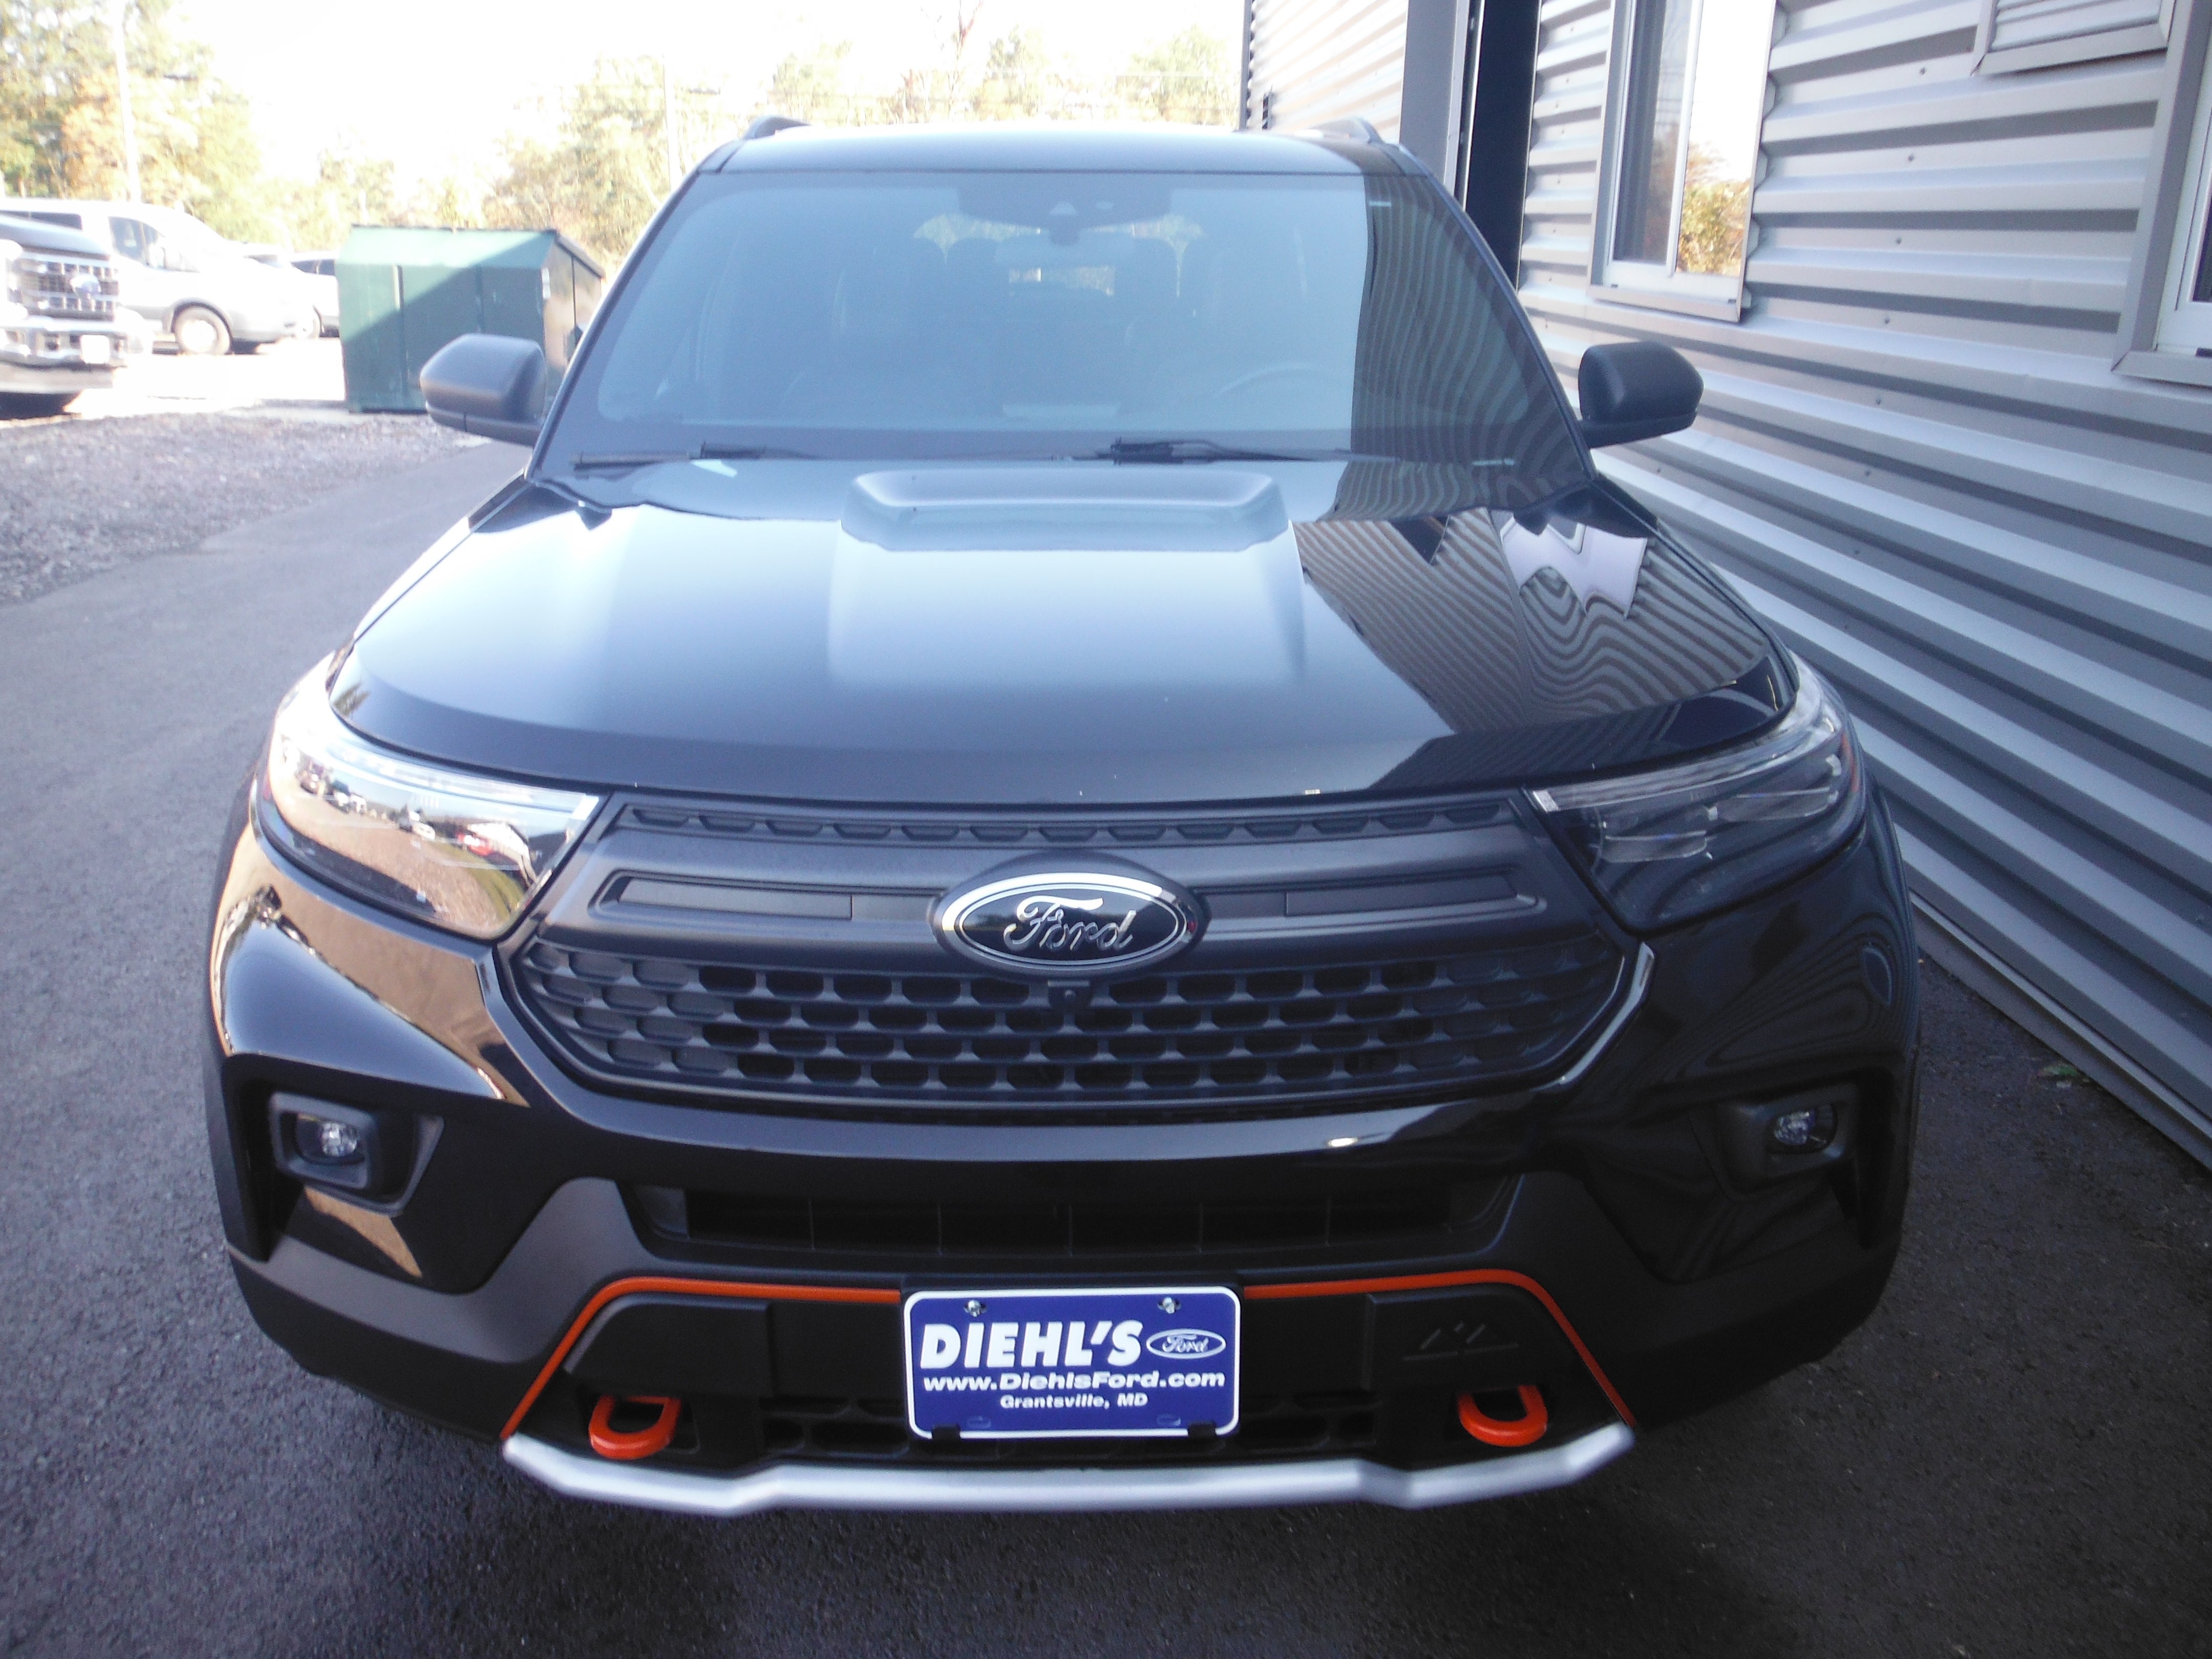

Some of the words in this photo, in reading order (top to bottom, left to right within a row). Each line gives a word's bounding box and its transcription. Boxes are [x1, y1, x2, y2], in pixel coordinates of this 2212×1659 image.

[1004, 895, 1137, 951] Ford
[921, 1320, 1143, 1369] DIEHL'S
[1162, 1333, 1209, 1353] Ford
[923, 1371, 1225, 1391] www.DiehlsFord.com
[1000, 1393, 1110, 1409] Grantsville,
[1117, 1393, 1148, 1407] MD
